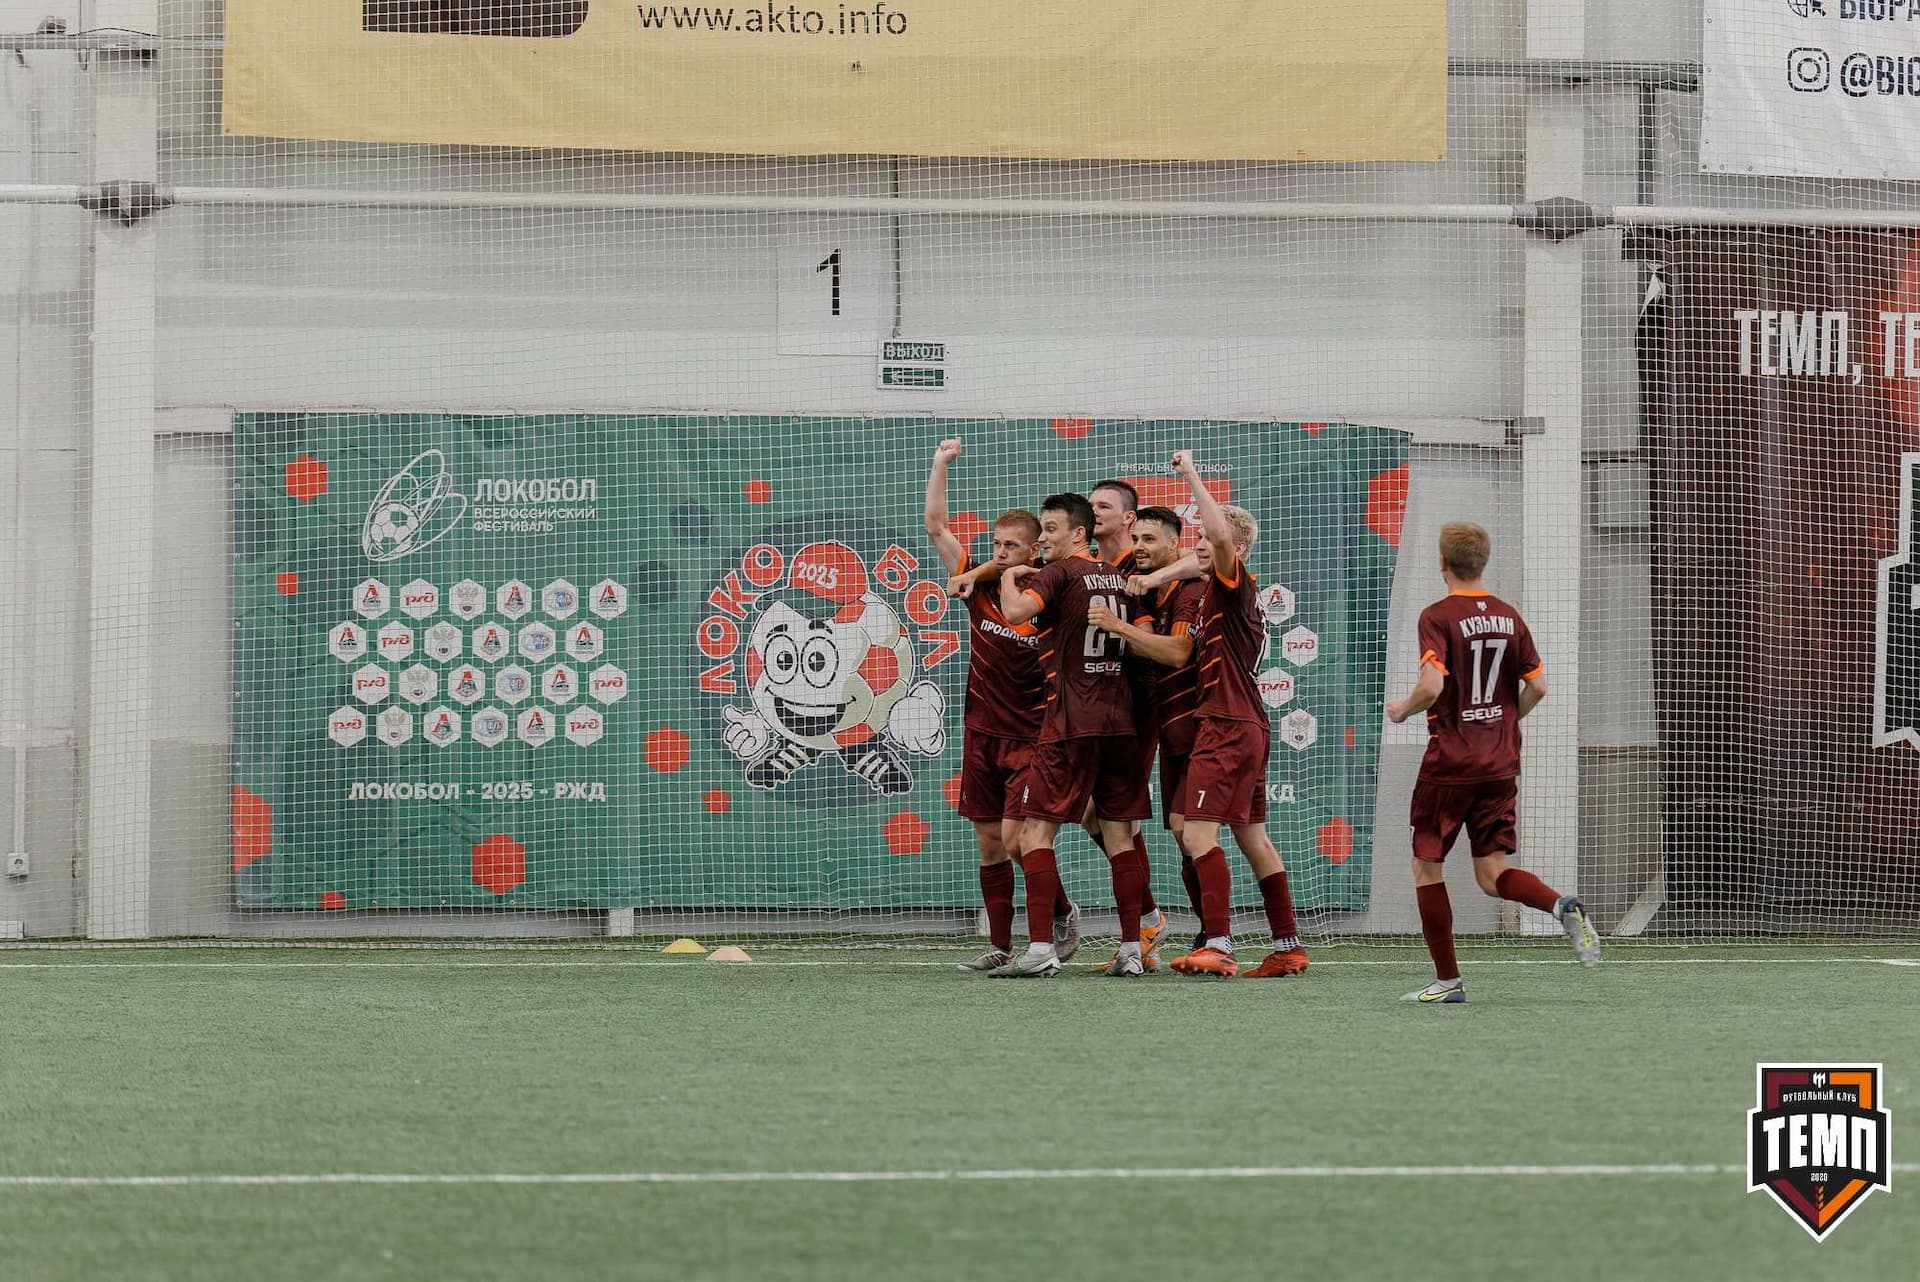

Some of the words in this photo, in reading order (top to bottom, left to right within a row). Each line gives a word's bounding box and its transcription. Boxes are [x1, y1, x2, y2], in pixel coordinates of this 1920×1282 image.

[637, 0, 908, 35] www.akto.info
[817, 247, 842, 316] 1
[885, 345, 943, 359] ВЫХОД
[1733, 310, 1862, 386] ТЕМП,
[474, 478, 596, 502] ЛОКОБОЛ
[474, 505, 596, 519] ВСЕРОССИЙСКИЙ
[473, 520, 554, 532] ФЕСТИВАЛЬ
[796, 561, 838, 590] 2025
[1459, 615, 1514, 638] КУЗЬКИН
[1470, 639, 1507, 705] 17
[1462, 705, 1502, 721] SEUS
[349, 782, 460, 800] ЛОКОБОЛ
[481, 782, 534, 800] 2025
[554, 782, 606, 802] РЖД
[1198, 790, 1206, 808] 7
